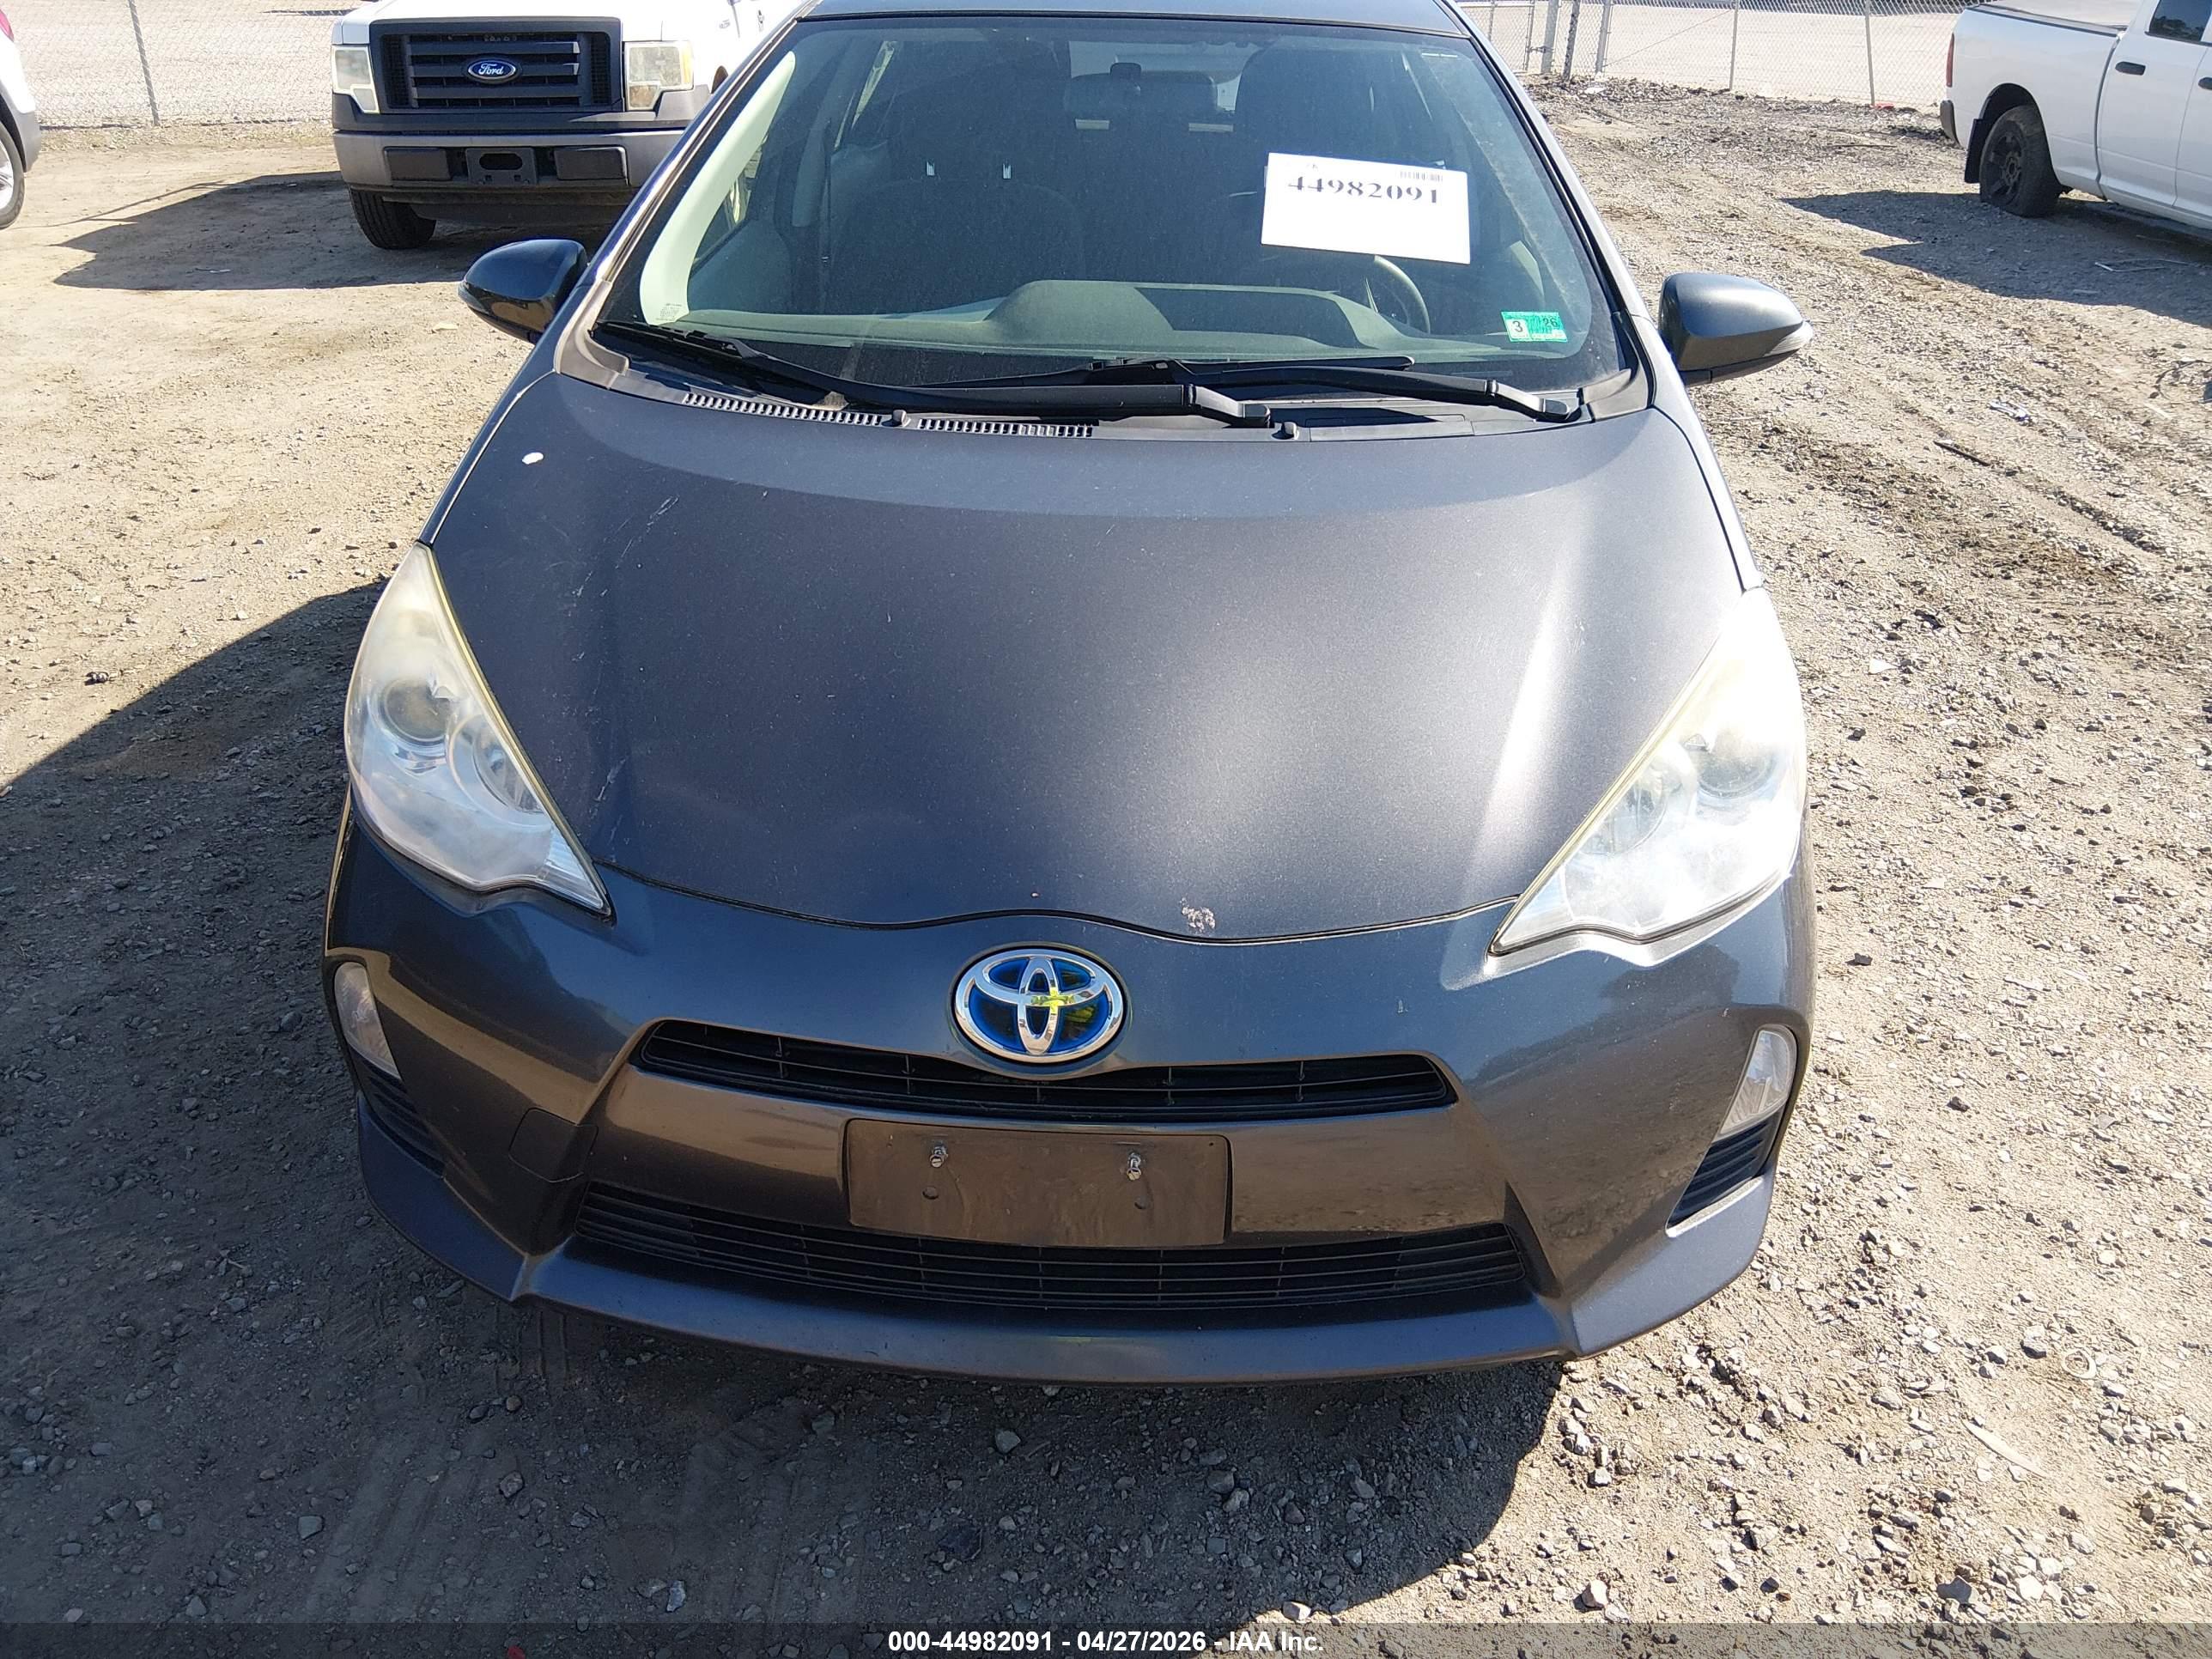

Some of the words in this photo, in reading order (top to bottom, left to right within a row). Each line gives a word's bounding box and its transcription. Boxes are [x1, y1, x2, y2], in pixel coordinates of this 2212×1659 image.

[478, 64, 504, 75] Ford
[1287, 176, 1437, 204] 44982091
[1512, 320, 1523, 332] 3
[1542, 317, 1559, 327] 26
